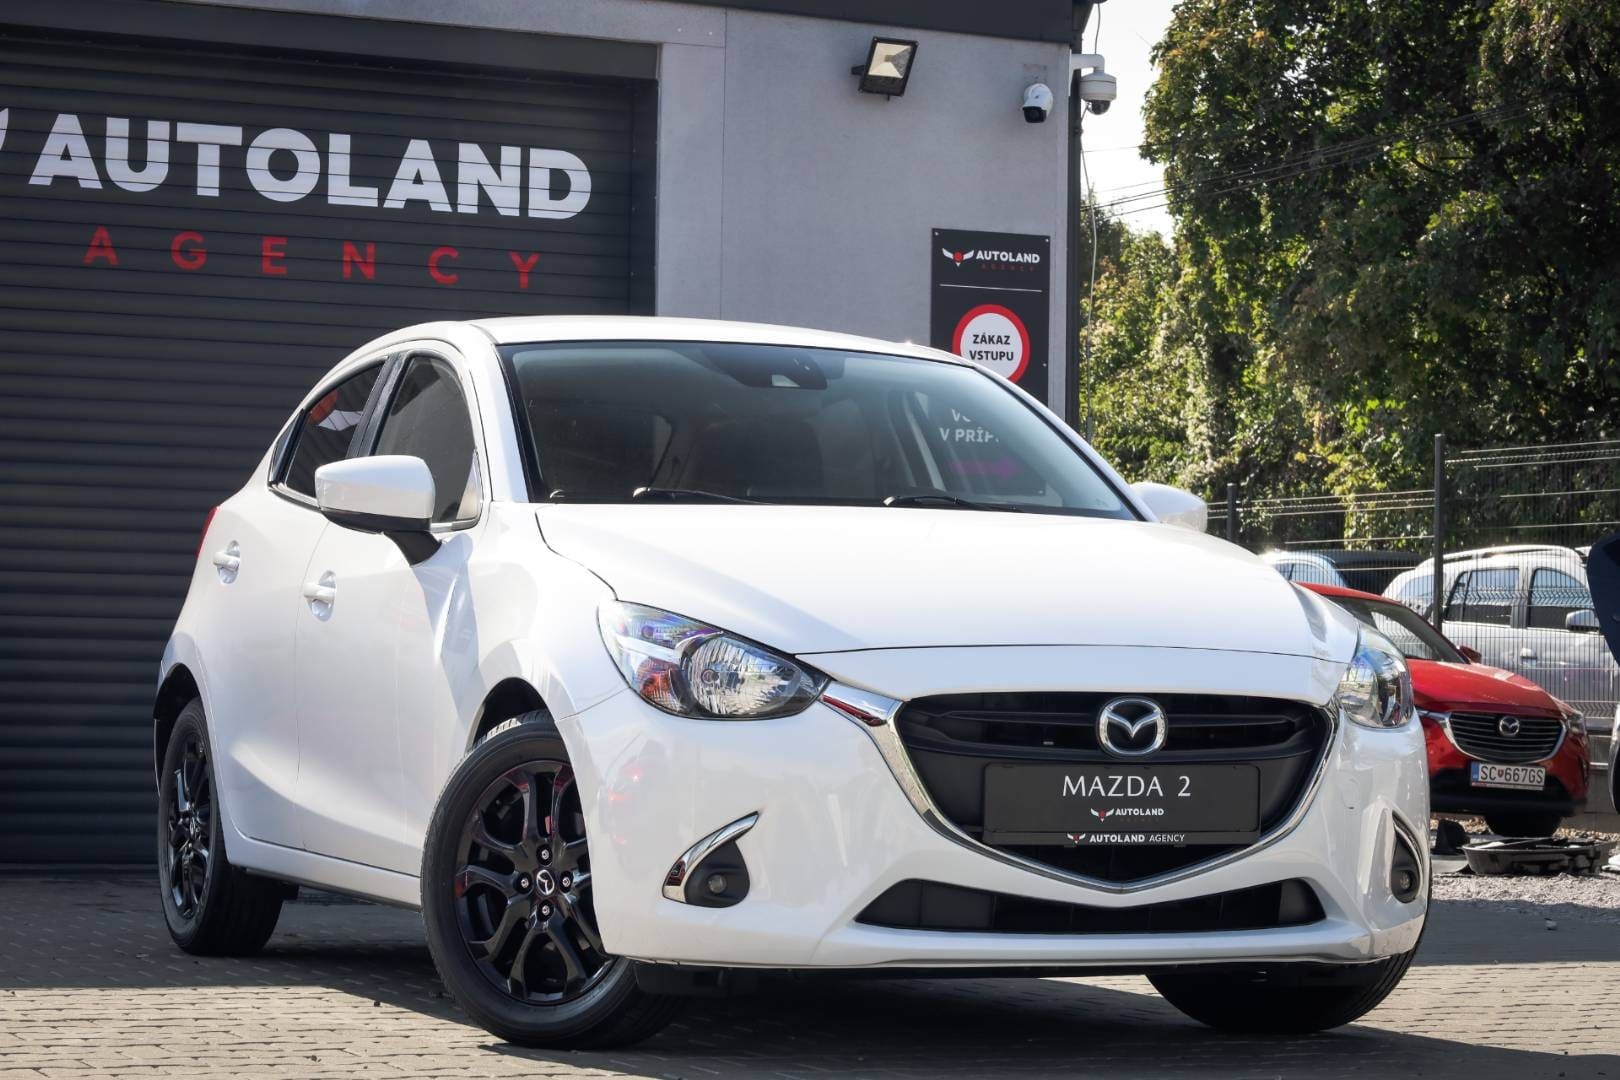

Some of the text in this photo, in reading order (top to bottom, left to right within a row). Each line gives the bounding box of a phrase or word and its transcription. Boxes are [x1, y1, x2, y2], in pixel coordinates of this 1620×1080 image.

[28, 113, 593, 221] AUTOLAND
[83, 226, 541, 289] AGENCY
[975, 250, 1040, 264] AUTOLAND
[972, 333, 1011, 346] ZÁKAZ
[969, 350, 1014, 362] VSTUPU
[939, 427, 950, 441] V
[1062, 775, 1192, 797] MAZDA 2
[1115, 807, 1164, 816] AUTOLAND
[1089, 833, 1185, 843] AUTOLAND AGENCY
